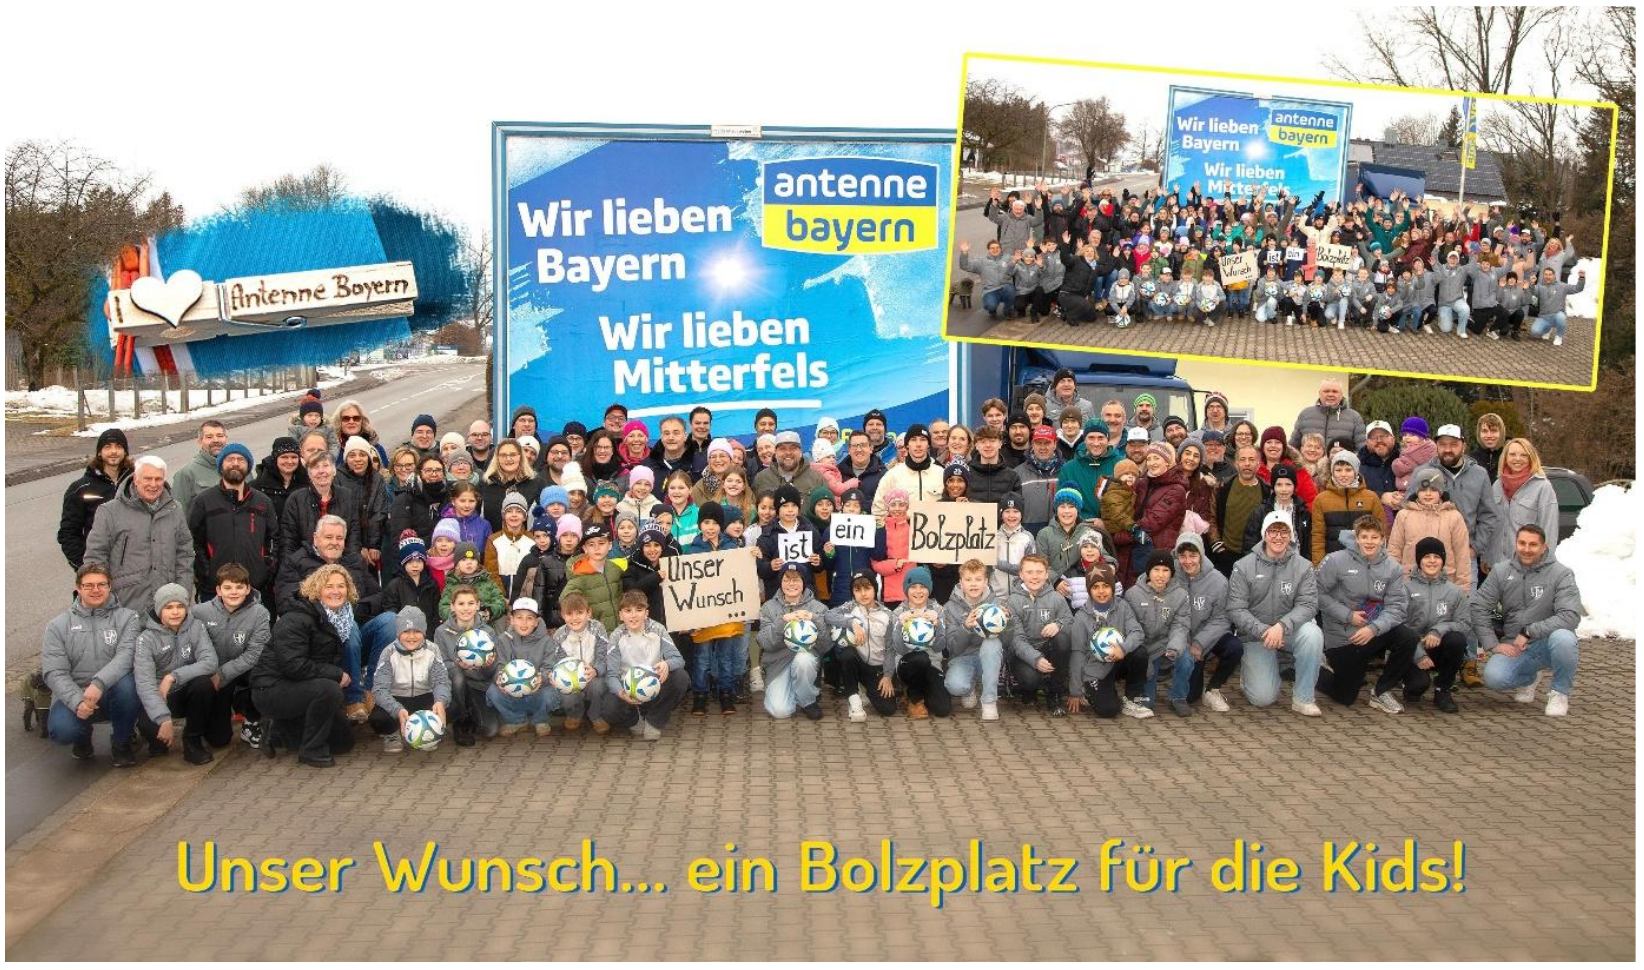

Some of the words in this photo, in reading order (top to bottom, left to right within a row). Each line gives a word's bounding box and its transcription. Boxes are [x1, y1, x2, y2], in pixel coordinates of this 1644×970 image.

[1176, 116, 1205, 132] Wir
[1208, 117, 1259, 135] lieben
[1275, 112, 1334, 128] antenne
[1182, 134, 1240, 154] Bayern
[1278, 127, 1329, 145] bayern
[773, 168, 928, 198] antenne
[1204, 162, 1232, 178] Wir
[1236, 162, 1286, 181] lieben
[517, 199, 593, 238] Wir
[603, 197, 733, 236] lieben
[786, 209, 915, 251] bayern
[536, 248, 686, 292] Bayern
[114, 295, 124, 323] I
[230, 282, 327, 311] Antenne
[598, 312, 672, 351] Wir
[682, 310, 810, 349] lieben
[613, 352, 830, 395] Mitterfels
[834, 517, 865, 541] ein
[911, 512, 996, 562] Bolzplatz
[783, 532, 809, 561] ist
[667, 554, 725, 581] Unser
[669, 578, 744, 612] Wunsch
